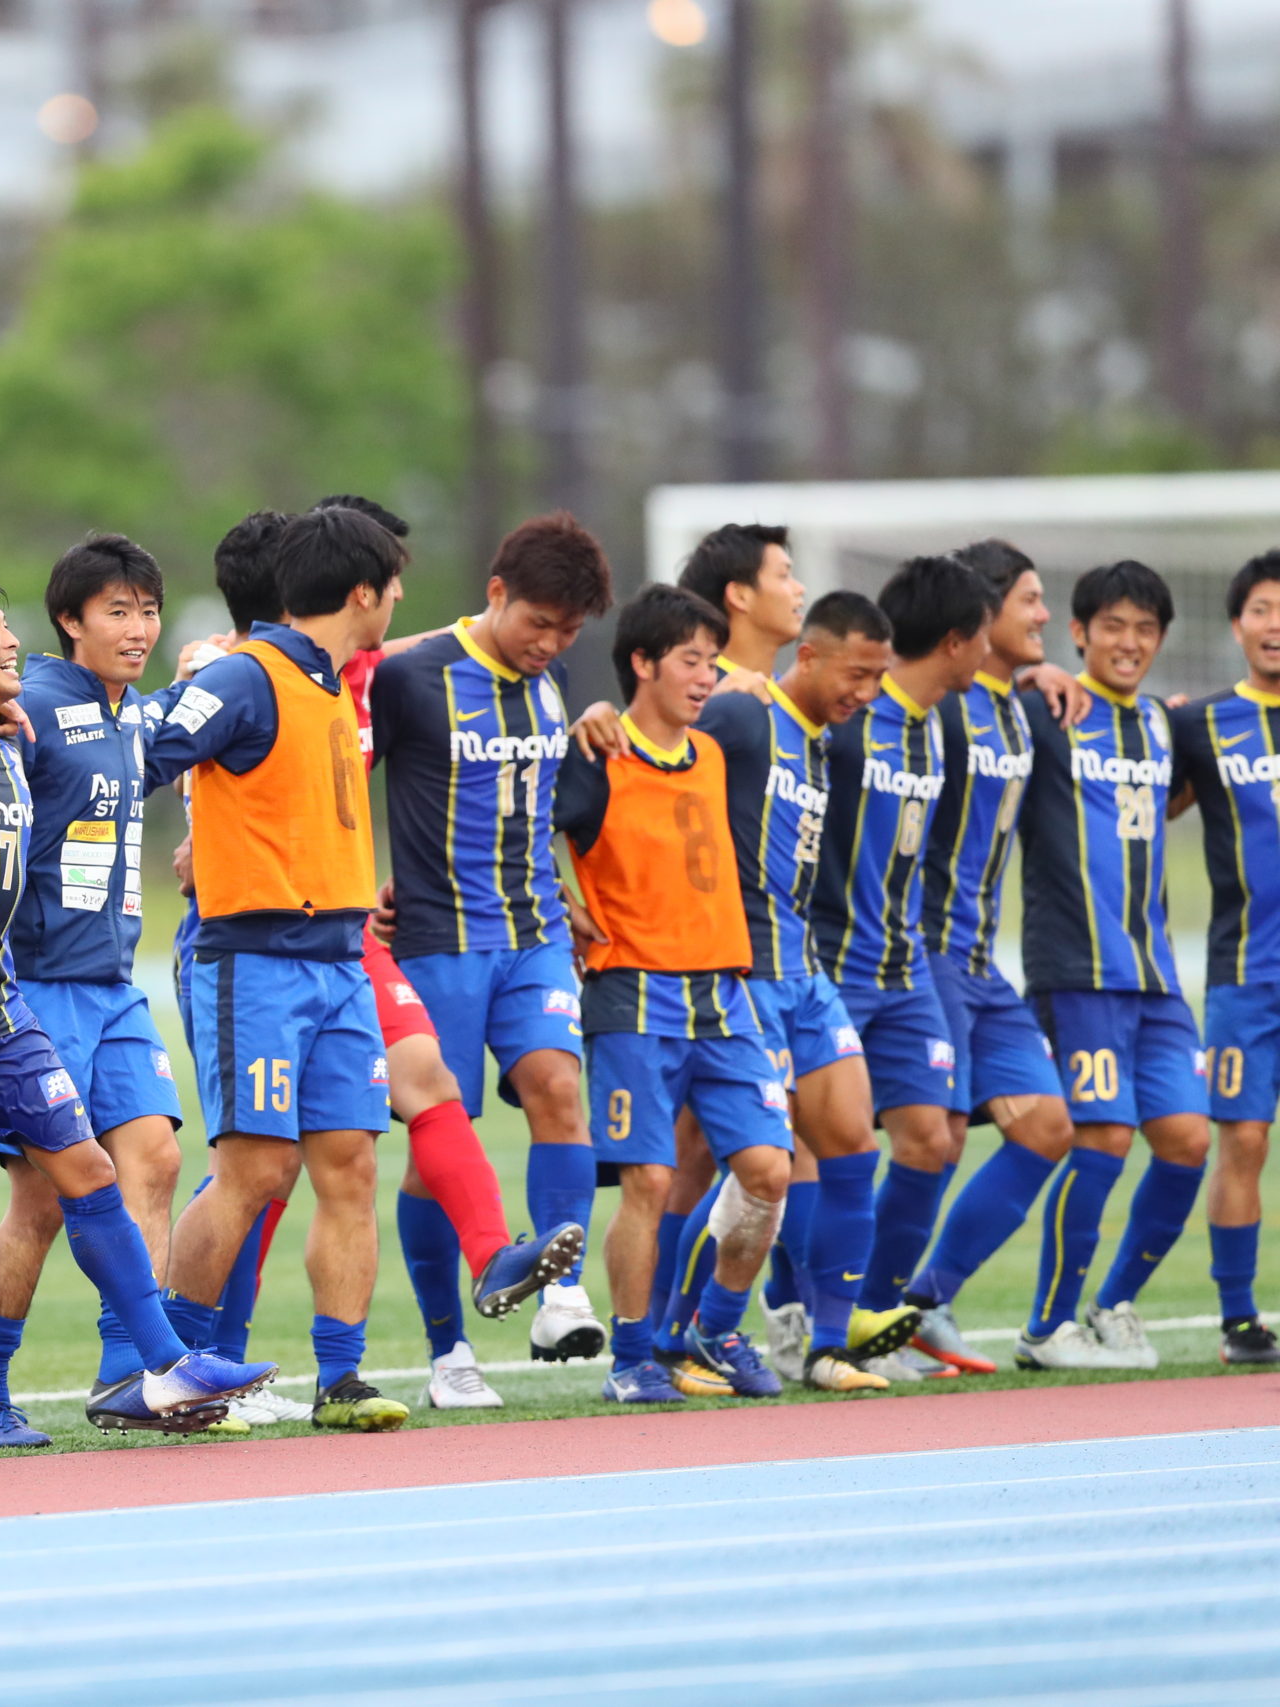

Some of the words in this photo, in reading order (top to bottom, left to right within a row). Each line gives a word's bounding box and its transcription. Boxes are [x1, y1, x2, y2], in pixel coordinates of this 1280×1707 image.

[66, 730, 105, 745] ATHLETA
[328, 718, 356, 831] 6
[496, 762, 540, 817] 11
[1217, 753, 1280, 788] Ma
[898, 800, 923, 857] 6
[1114, 784, 1155, 840] 20
[672, 791, 719, 894] 8
[247, 1057, 291, 1113] 15
[1071, 1048, 1118, 1102] 20
[607, 1089, 632, 1140] 9
